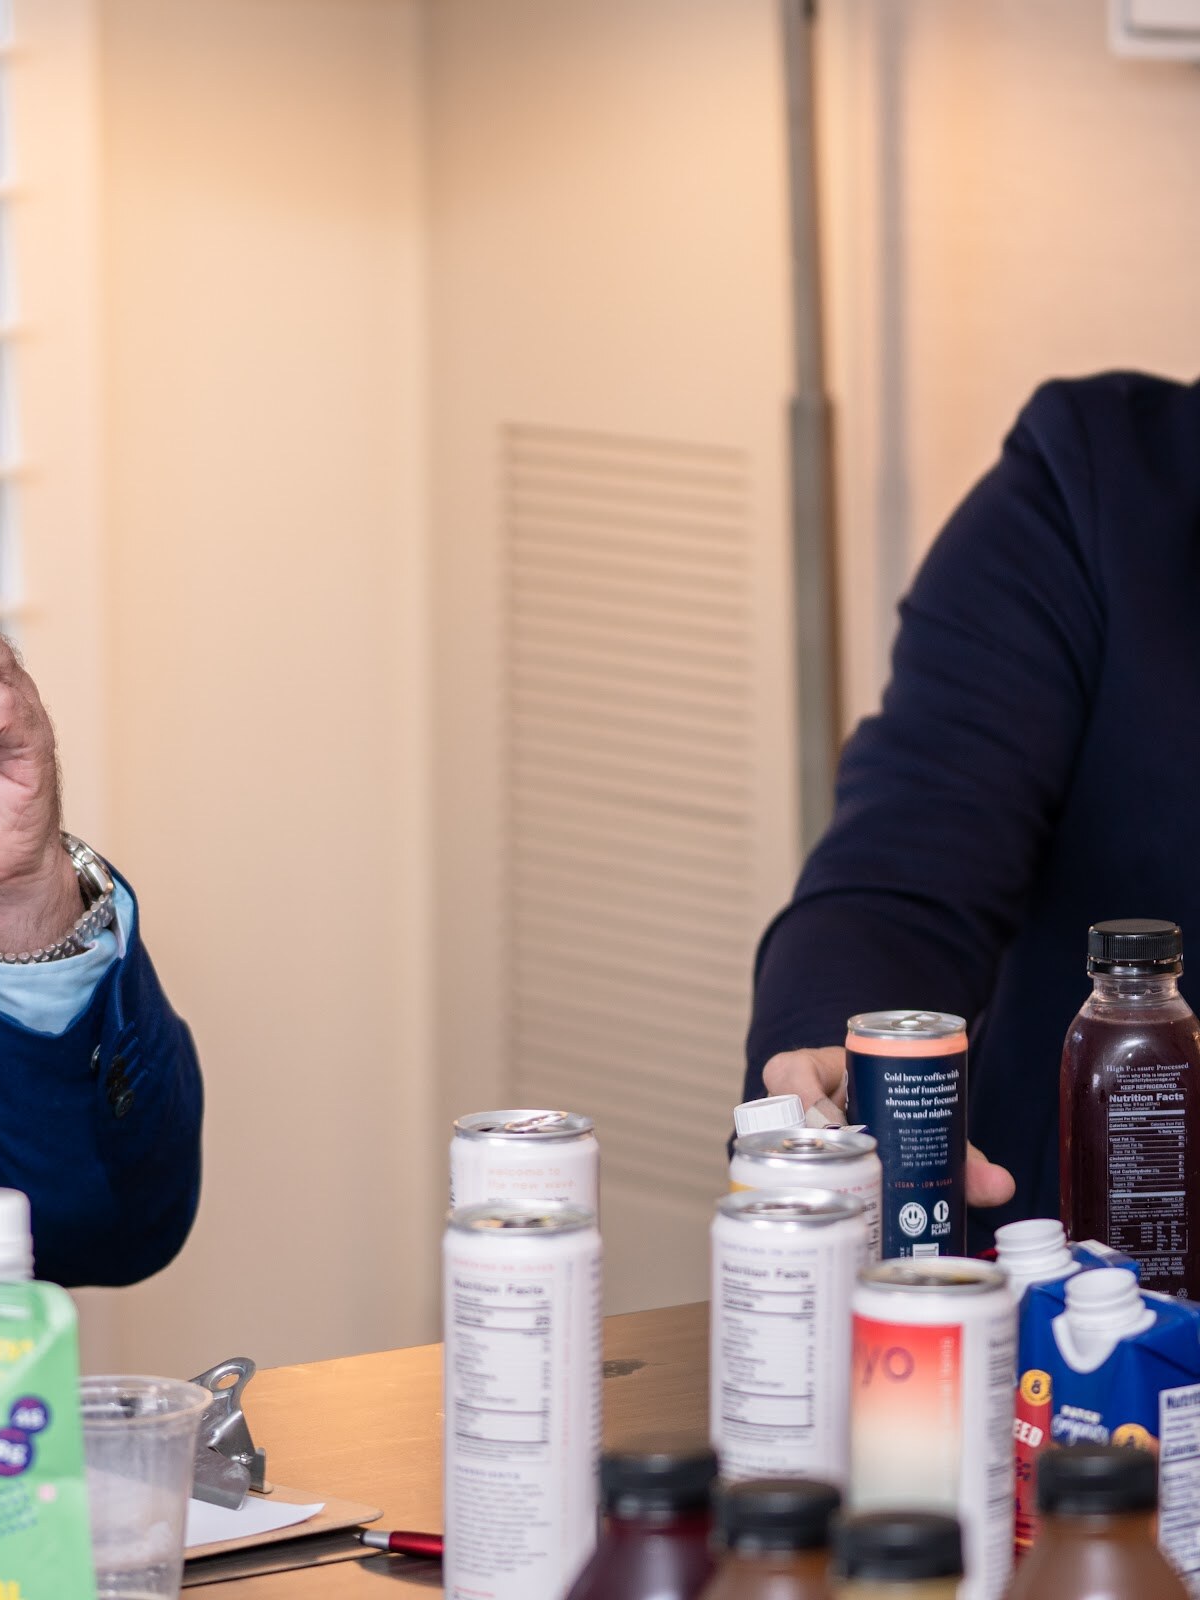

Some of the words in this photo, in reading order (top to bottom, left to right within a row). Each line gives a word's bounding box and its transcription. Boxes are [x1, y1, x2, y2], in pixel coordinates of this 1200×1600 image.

[1106, 1065, 1124, 1073] High
[1157, 1062, 1189, 1071] Processed
[885, 1072, 901, 1081] Cold
[903, 1073, 921, 1081] brew
[924, 1072, 946, 1081] coffee
[946, 1069, 959, 1079] with
[894, 1085, 910, 1094] side
[911, 1086, 920, 1094] of
[921, 1082, 956, 1093] functional
[886, 1097, 919, 1106] shrooms
[921, 1097, 933, 1106] for
[934, 1093, 958, 1105] focused
[1156, 1093, 1184, 1101] Facts
[894, 1110, 911, 1120] days
[913, 1109, 927, 1118] and
[929, 1108, 952, 1119] nights.
